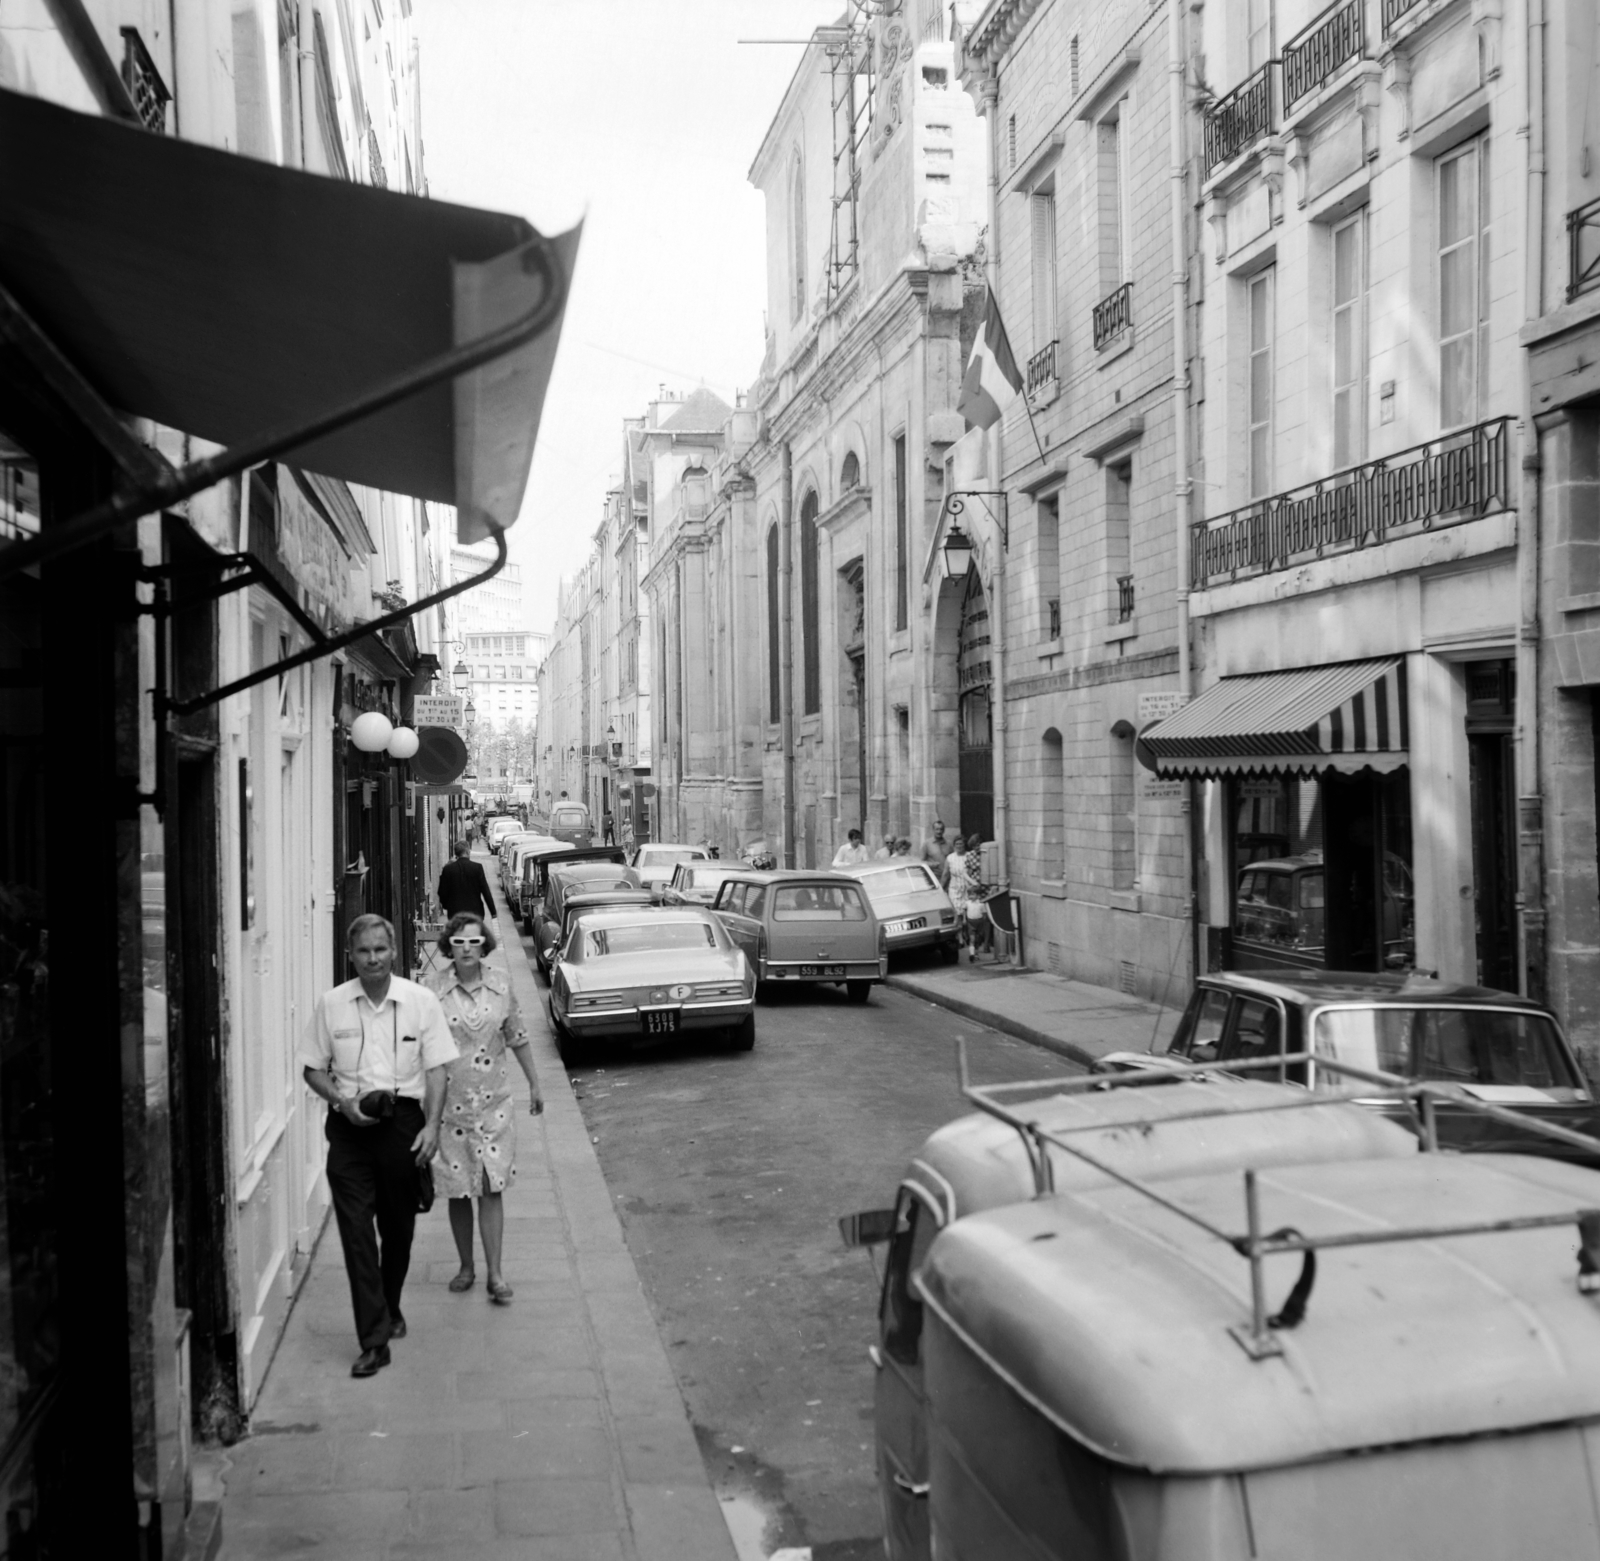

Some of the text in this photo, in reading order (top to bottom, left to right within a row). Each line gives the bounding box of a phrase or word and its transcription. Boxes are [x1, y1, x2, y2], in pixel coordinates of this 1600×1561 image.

[419, 699, 457, 707] INTERDIT
[801, 966, 817, 975] 559
[677, 986, 684, 998] F
